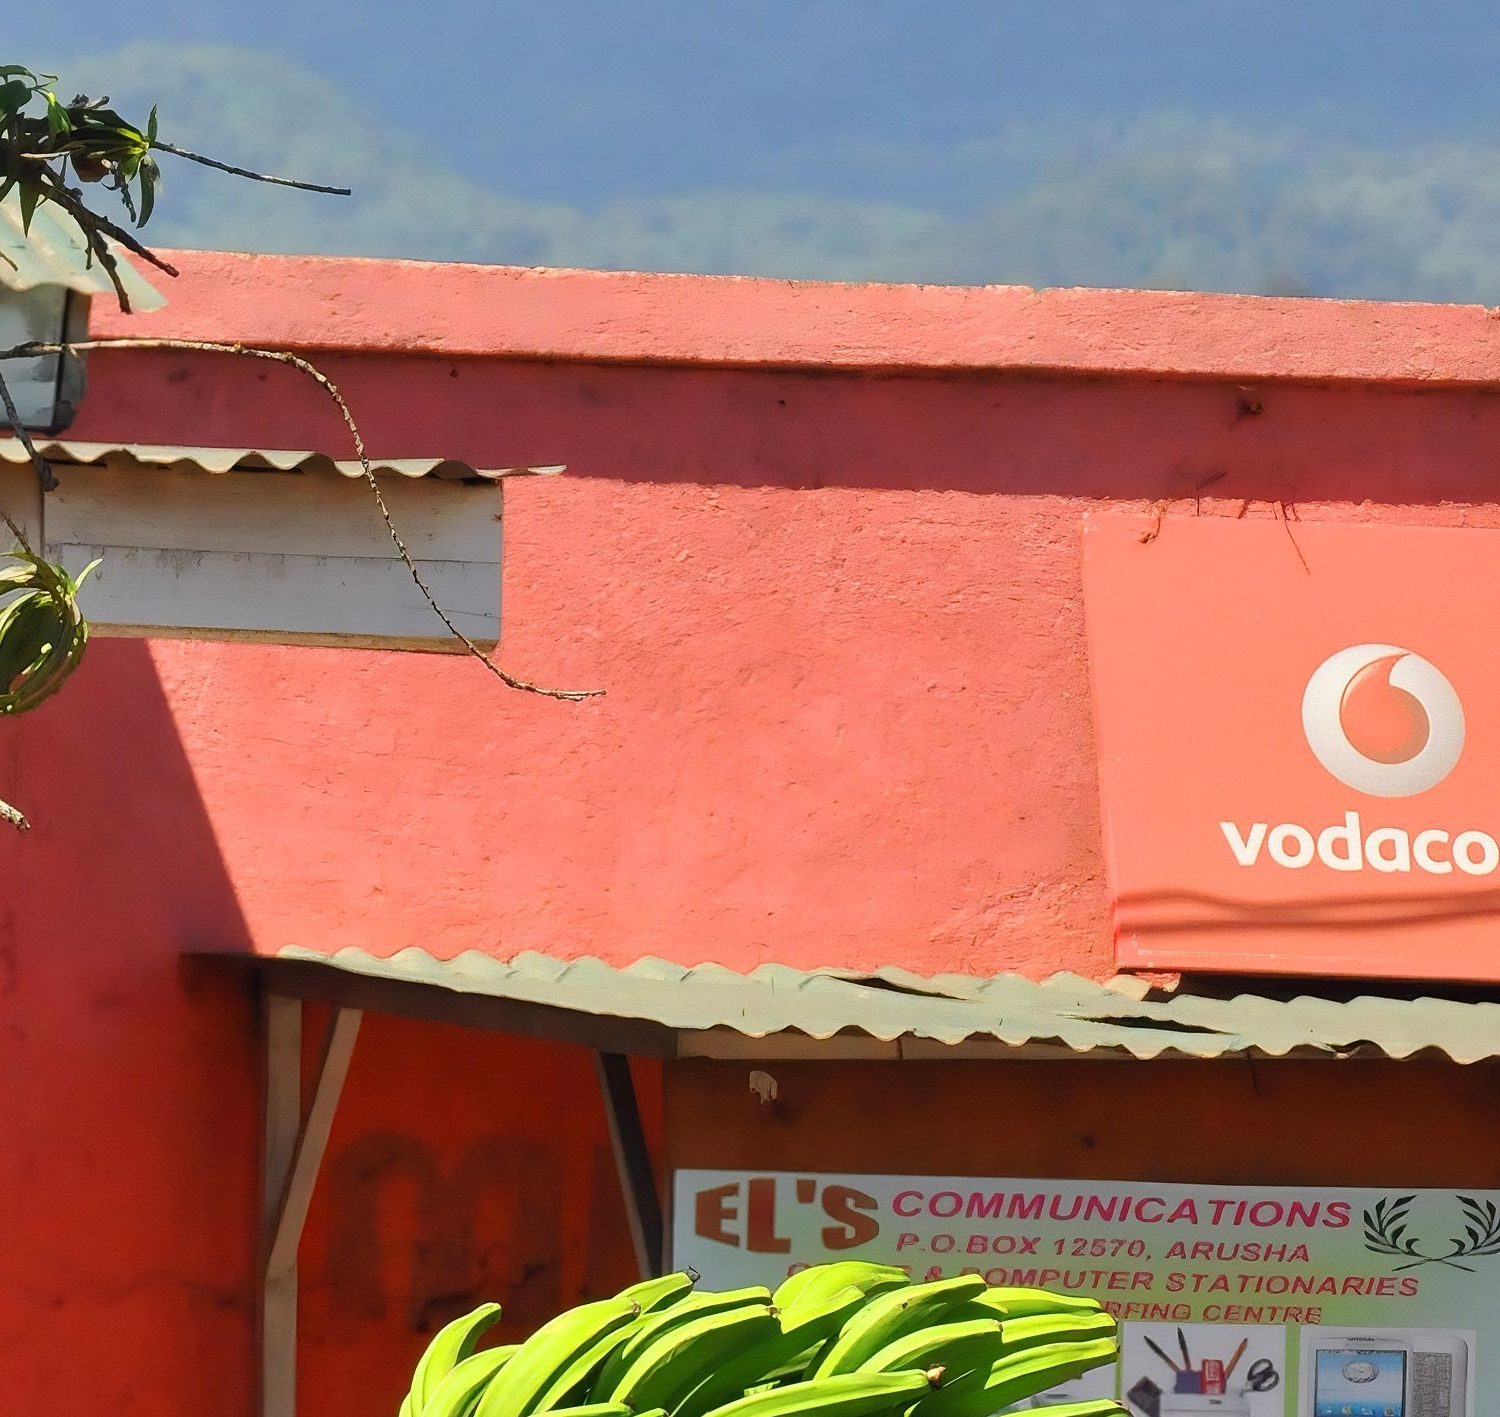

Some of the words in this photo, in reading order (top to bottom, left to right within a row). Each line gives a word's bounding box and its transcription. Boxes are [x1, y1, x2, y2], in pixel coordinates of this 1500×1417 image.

[1218, 810, 1500, 876] vodaco
[694, 1177, 880, 1255] EL'S
[891, 1189, 1352, 1229] COMMUNICATIONS
[1052, 1236, 1153, 1261] 12570,
[1164, 1240, 1310, 1263] ARUSHA
[1164, 1271, 1419, 1297] STATIONARIES
[1202, 1304, 1324, 1325] CENTRE
